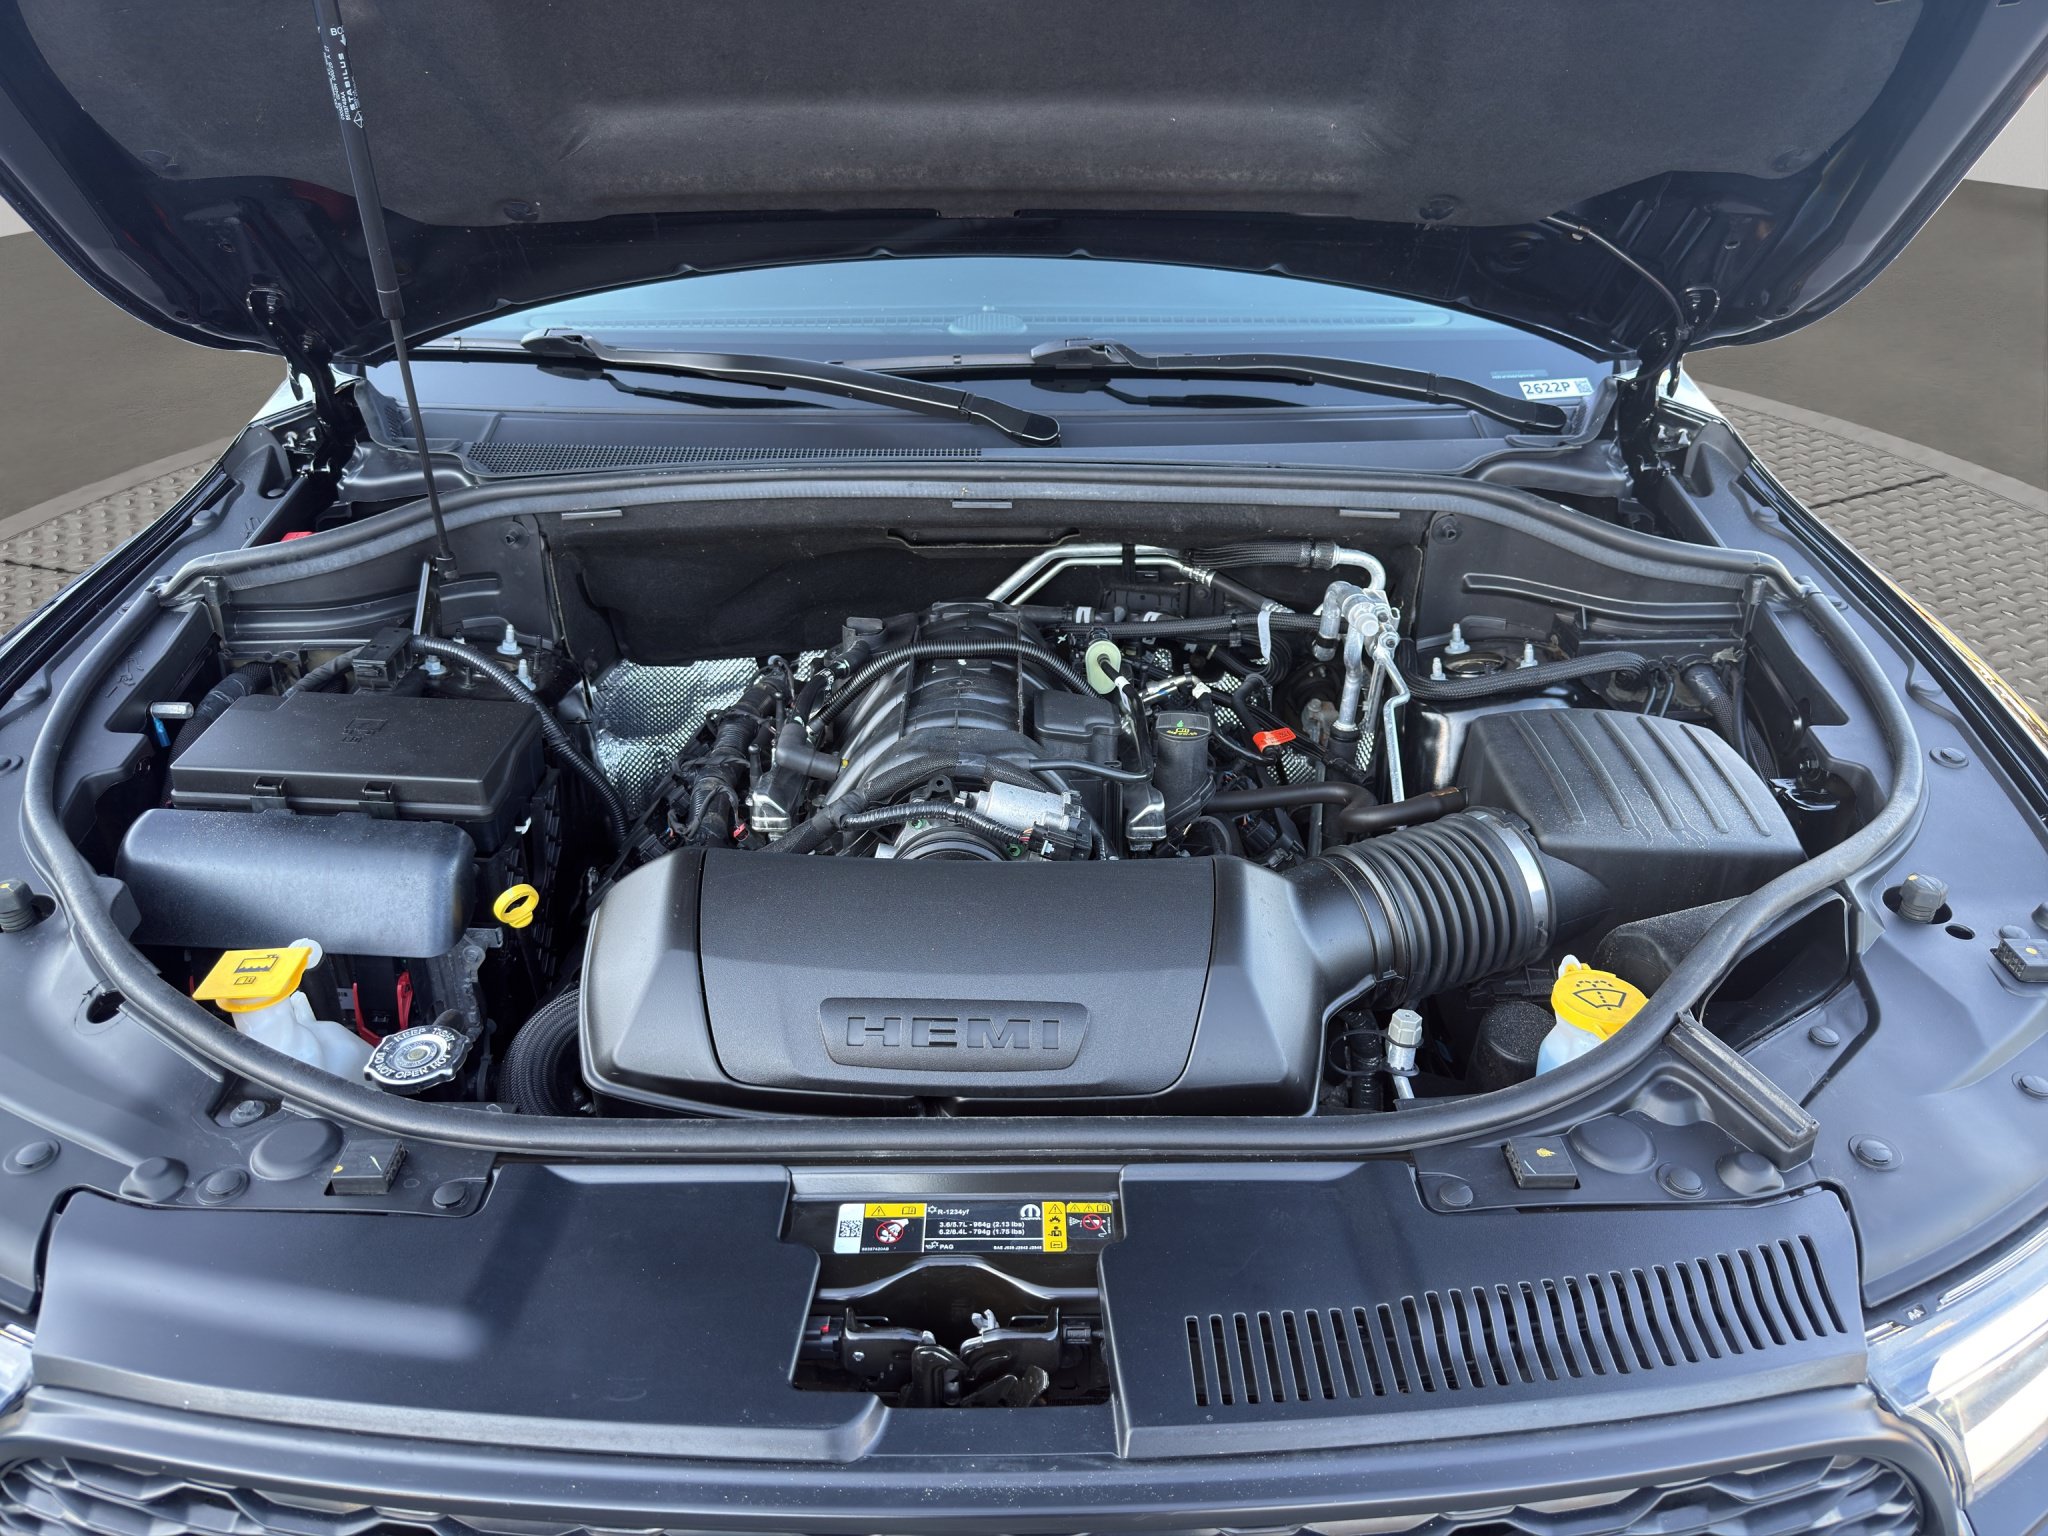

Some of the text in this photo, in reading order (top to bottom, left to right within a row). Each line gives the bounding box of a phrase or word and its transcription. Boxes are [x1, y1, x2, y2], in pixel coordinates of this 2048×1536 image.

[338, 53, 356, 111] STABILUS
[1523, 382, 1570, 394] 2622P
[394, 1027, 427, 1043] KEEP
[847, 1016, 1060, 1050] HEMI
[376, 1063, 396, 1076] NOT
[937, 1208, 970, 1216] R-1234yf
[973, 1221, 991, 1229] 964g
[992, 1221, 1010, 1229] (2.13
[1011, 1221, 1025, 1229] lbs)
